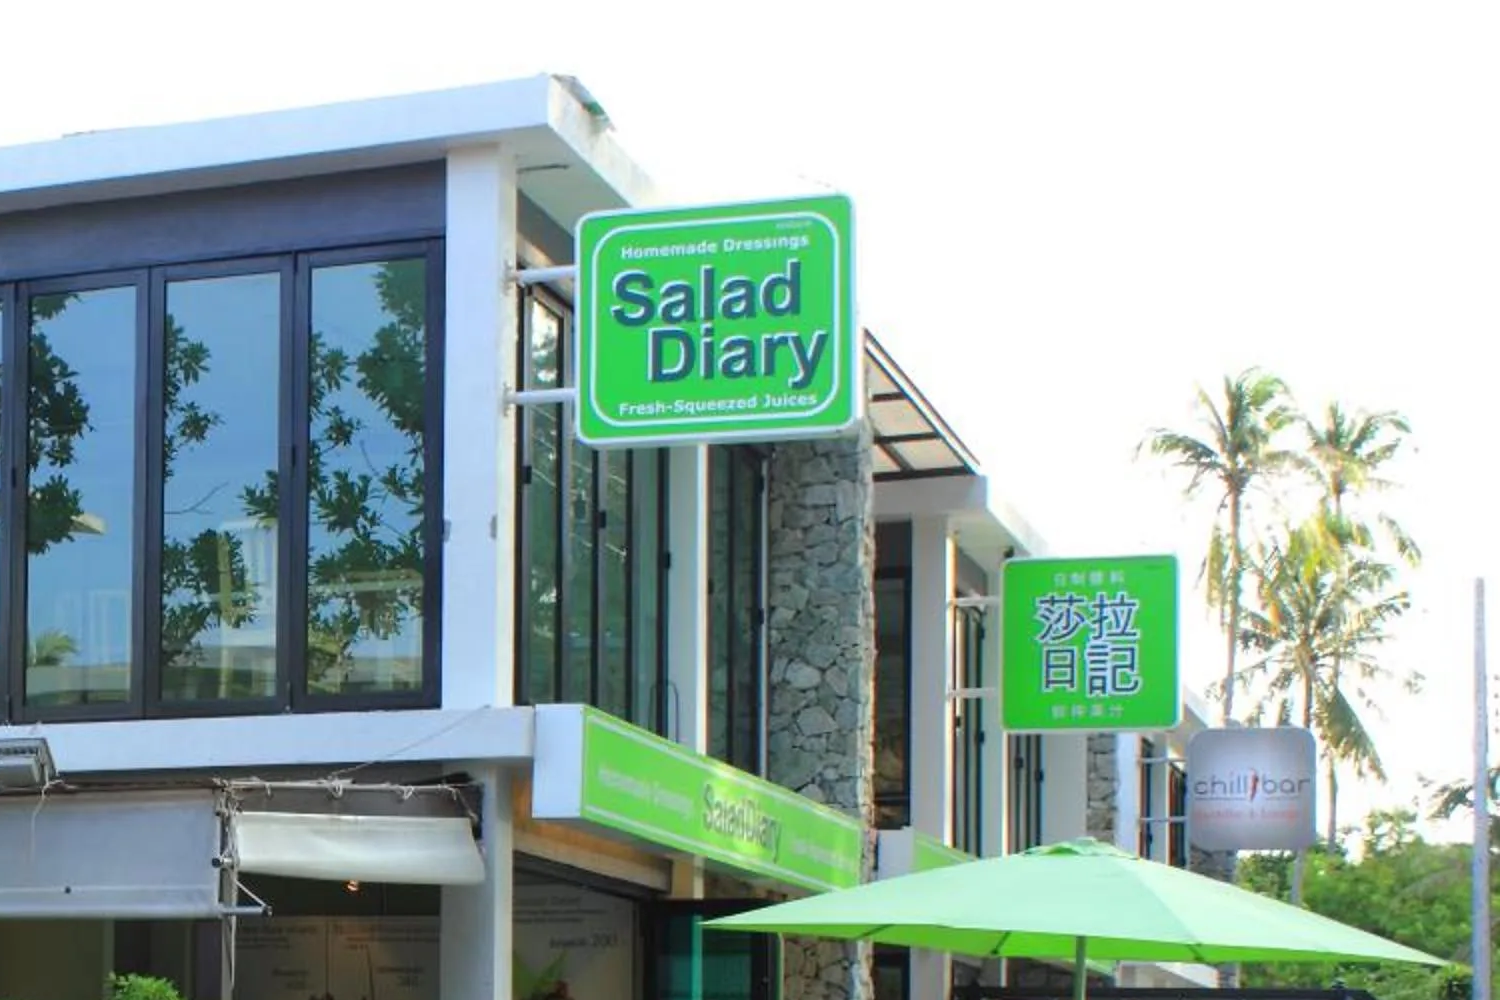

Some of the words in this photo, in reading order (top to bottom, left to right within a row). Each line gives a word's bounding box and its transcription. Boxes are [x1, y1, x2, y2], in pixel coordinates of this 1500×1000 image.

[621, 238, 718, 260] Homemade
[722, 233, 810, 254] Dressings
[610, 256, 802, 327] Salad
[647, 324, 829, 390] Diary
[618, 396, 757, 416] Fresh-Squeezed
[762, 391, 818, 409] Juices
[1036, 592, 1140, 644] 莎拉
[1041, 643, 1143, 696] 日記
[1261, 774, 1310, 795] bar
